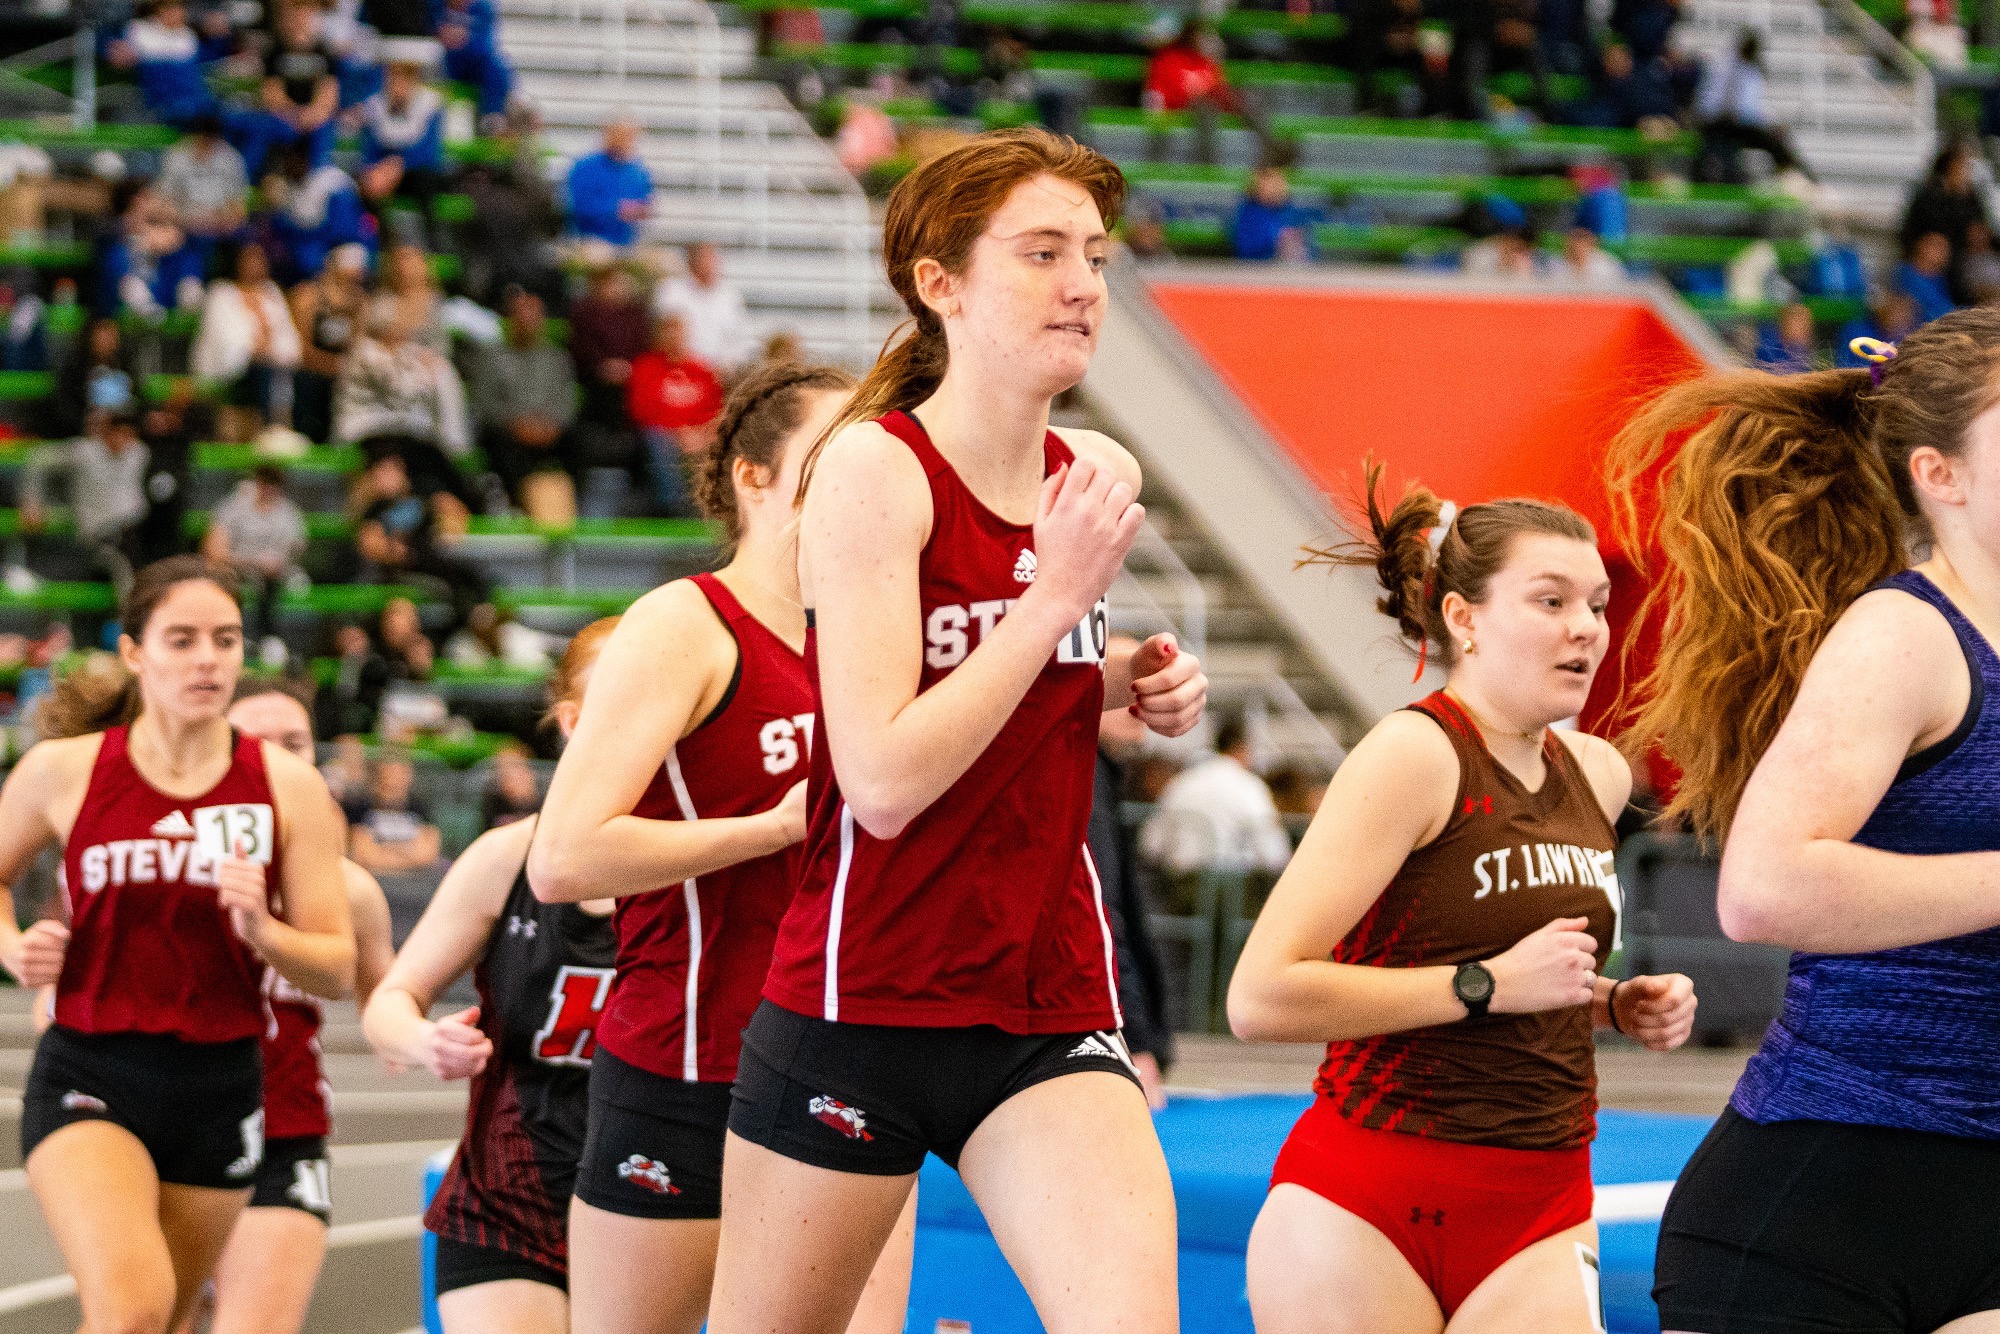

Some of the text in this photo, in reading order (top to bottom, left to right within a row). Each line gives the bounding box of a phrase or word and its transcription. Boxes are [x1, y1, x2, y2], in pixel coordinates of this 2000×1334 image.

[926, 598, 1020, 670] ST
[212, 808, 259, 855] 13
[80, 838, 221, 894] STEVE
[1473, 843, 1604, 900] ST. LAWRE
